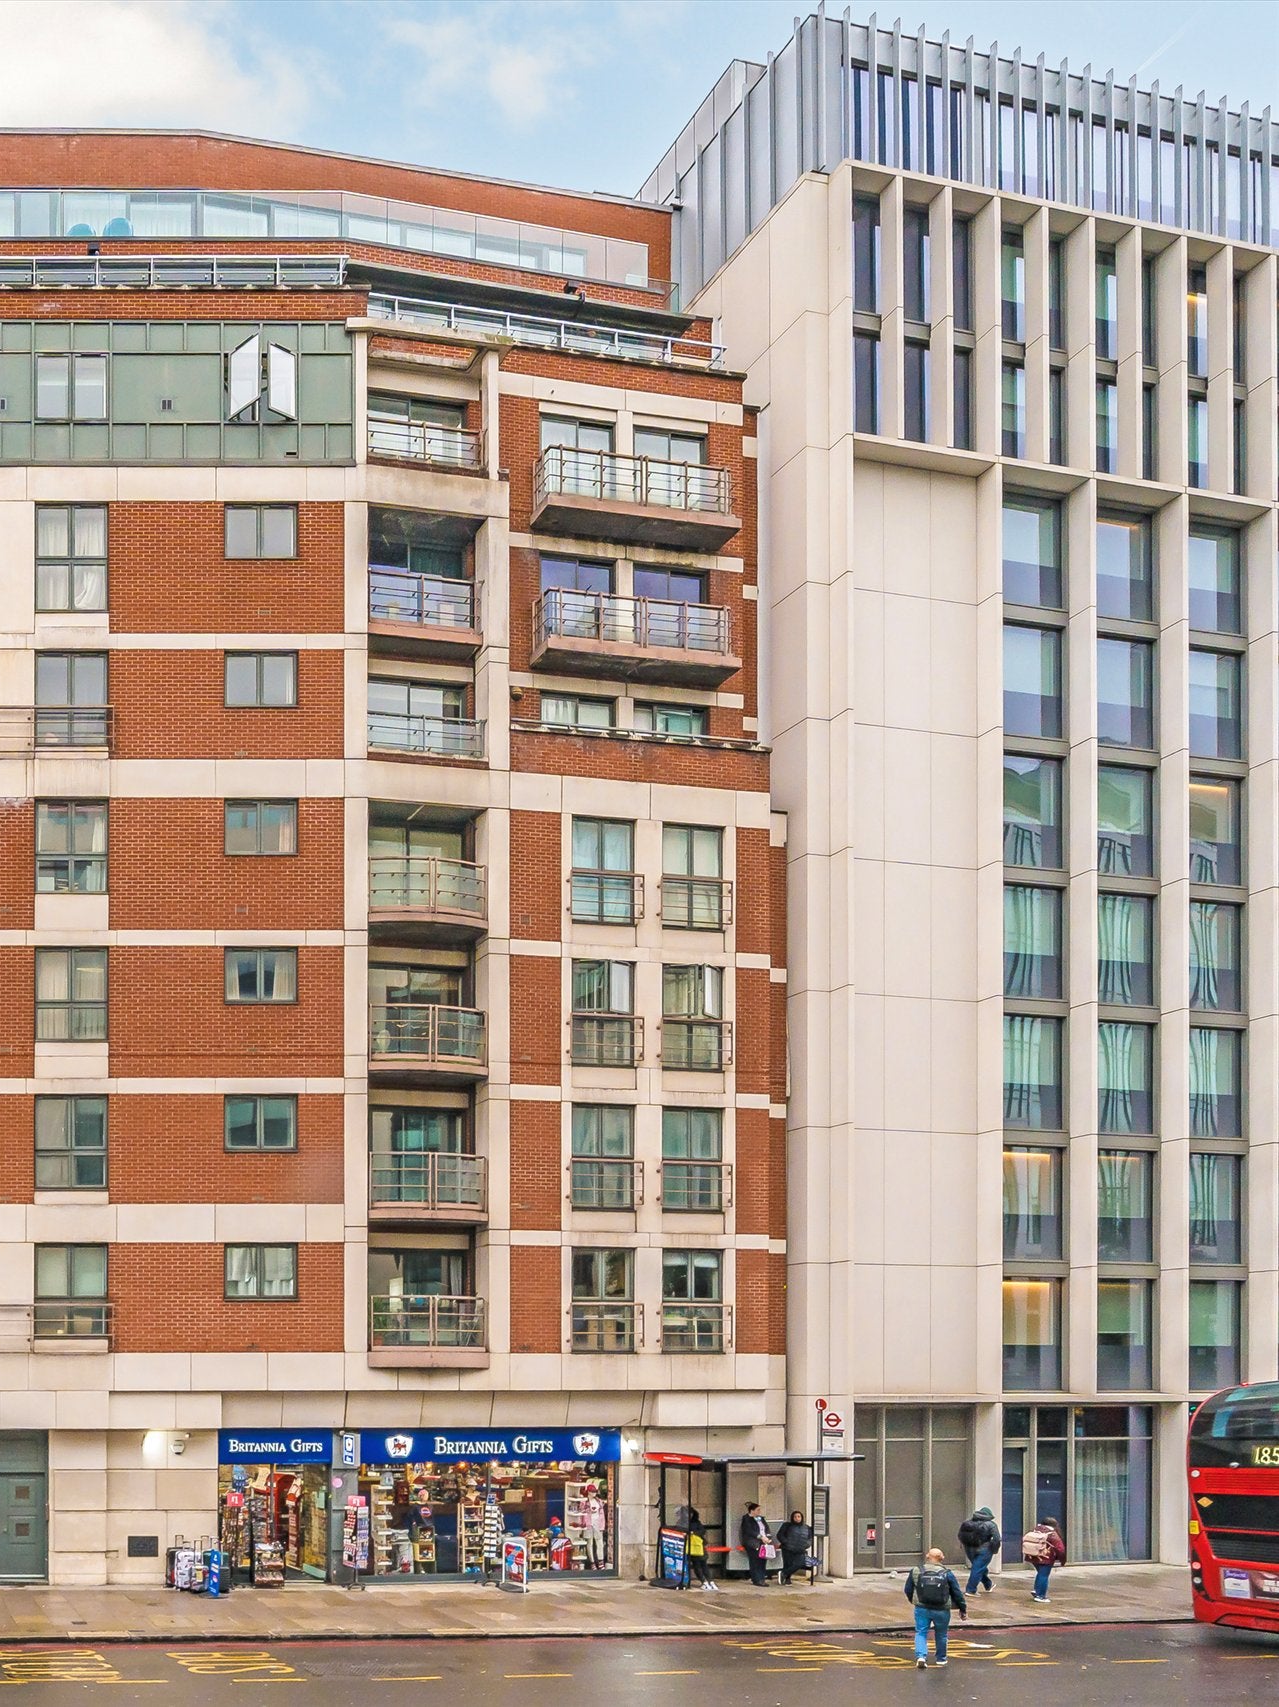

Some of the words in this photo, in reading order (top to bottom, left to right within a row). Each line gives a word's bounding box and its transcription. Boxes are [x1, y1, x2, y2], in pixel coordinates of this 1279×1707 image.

[229, 1439, 286, 1453] BRITANNIA
[291, 1439, 323, 1453] GIFTS
[434, 1436, 508, 1455] BRITANNIA
[512, 1436, 554, 1454] GIFTS
[1254, 1447, 1279, 1464] 185
[166, 1651, 296, 1675] BUS
